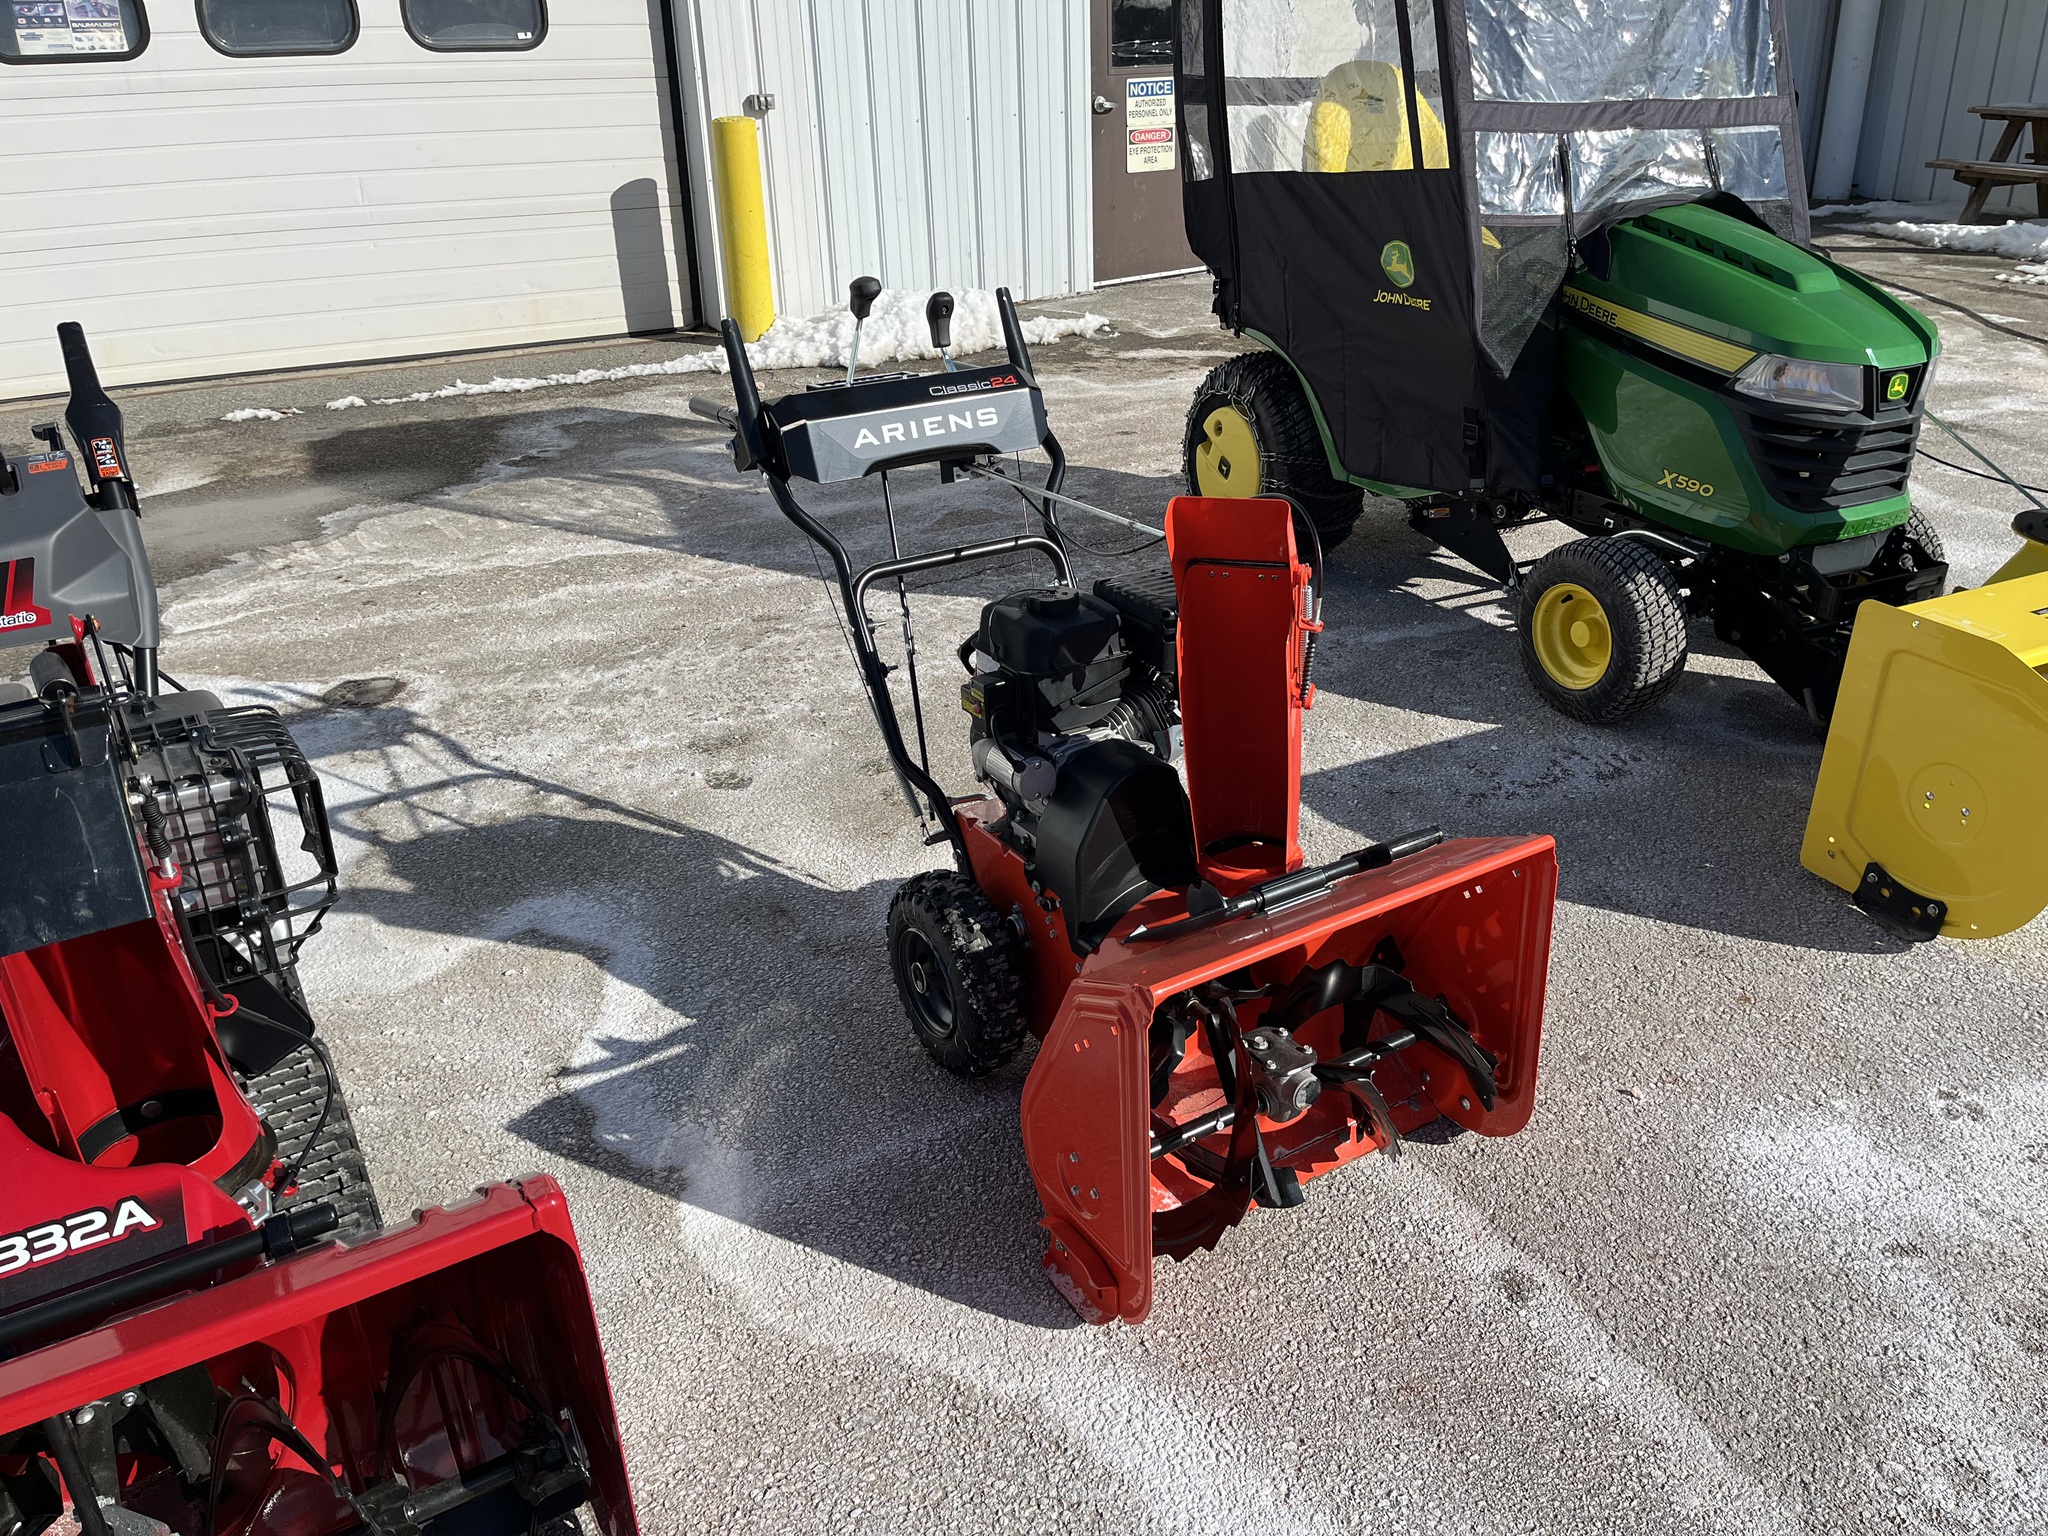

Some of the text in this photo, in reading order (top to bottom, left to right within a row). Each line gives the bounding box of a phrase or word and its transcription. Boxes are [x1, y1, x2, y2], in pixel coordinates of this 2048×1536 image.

[1130, 81, 1171, 96] NOTICE
[1135, 98, 1166, 108] AUTHORIZED
[1129, 108, 1173, 119] PERSONNEL ONLY
[1134, 131, 1167, 141] DANGER
[1129, 145, 1173, 156] EYE PROTECTION
[1143, 156, 1158, 164] AREA
[1373, 289, 1431, 311] JOHN DEERE
[1563, 289, 1618, 325] HN DEERE
[929, 375, 1017, 396] Classic24
[854, 407, 999, 449] ARIENS
[1656, 468, 1714, 497] X590
[0, 612, 35, 626] tatic
